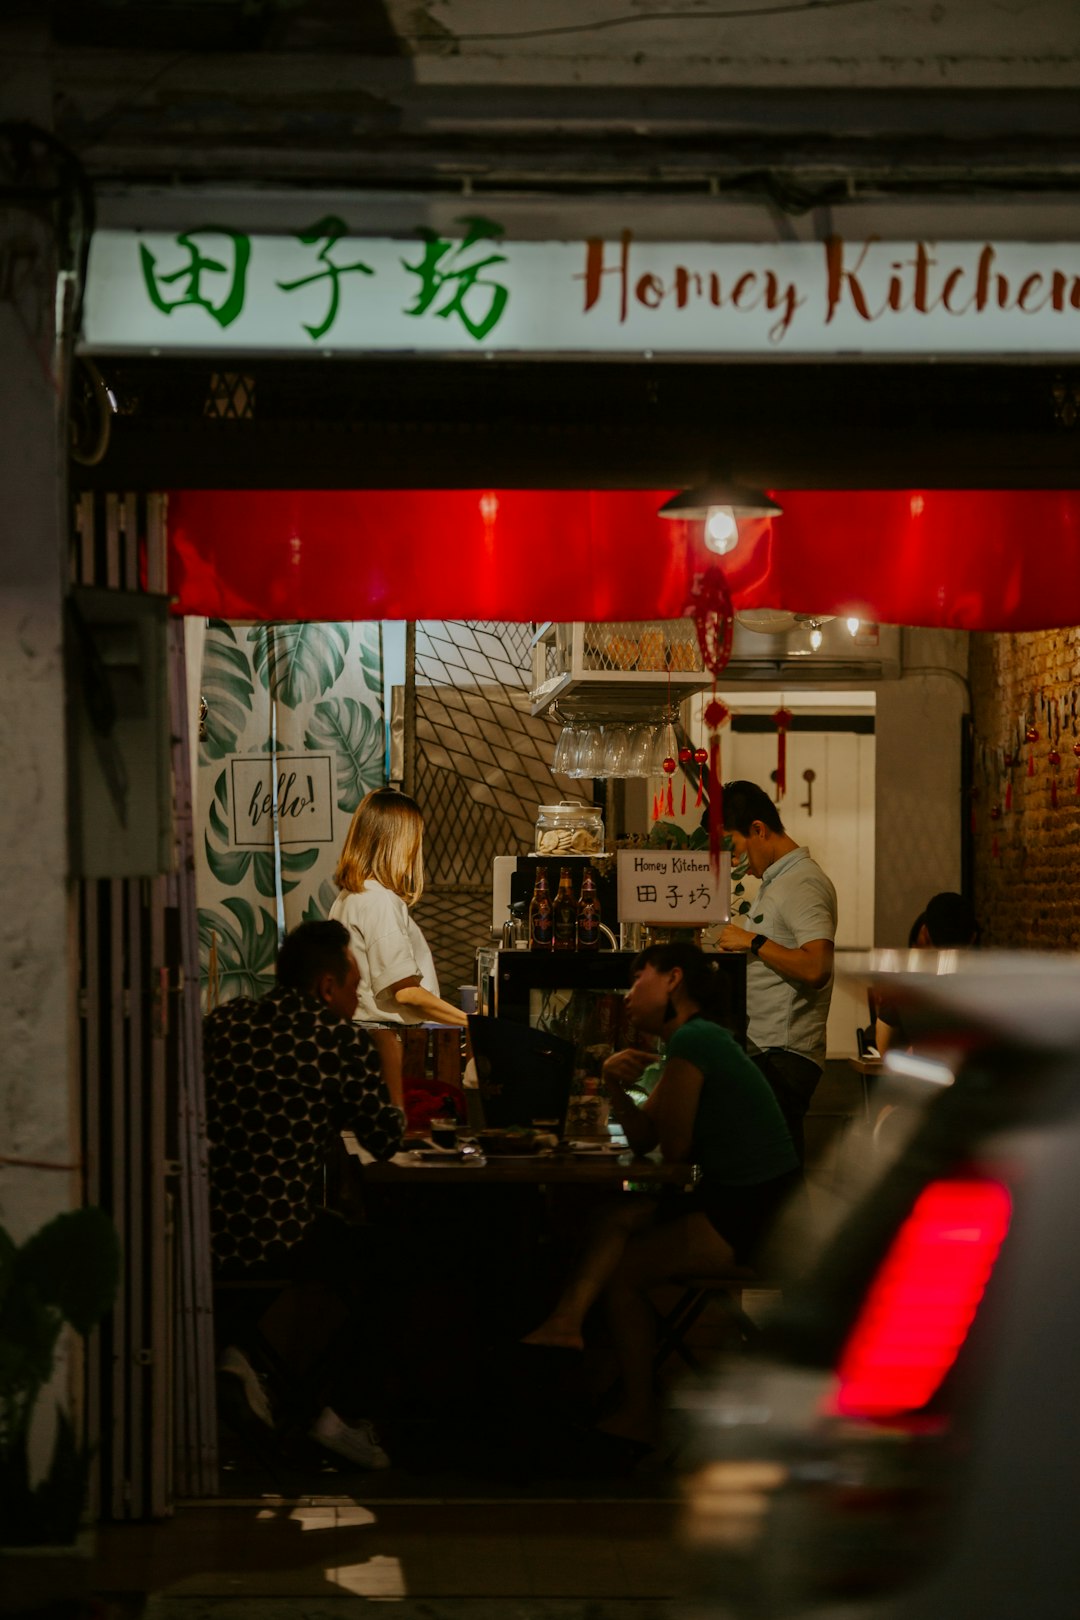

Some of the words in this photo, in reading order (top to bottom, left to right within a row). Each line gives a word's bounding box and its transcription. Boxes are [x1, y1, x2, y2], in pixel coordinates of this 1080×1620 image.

[138, 214, 510, 342] 田子坊
[572, 229, 805, 344] Homey
[248, 772, 315, 827] hello!
[634, 857, 667, 875] Homey
[672, 857, 710, 873] Kitchen
[636, 883, 711, 909] 田子坊
